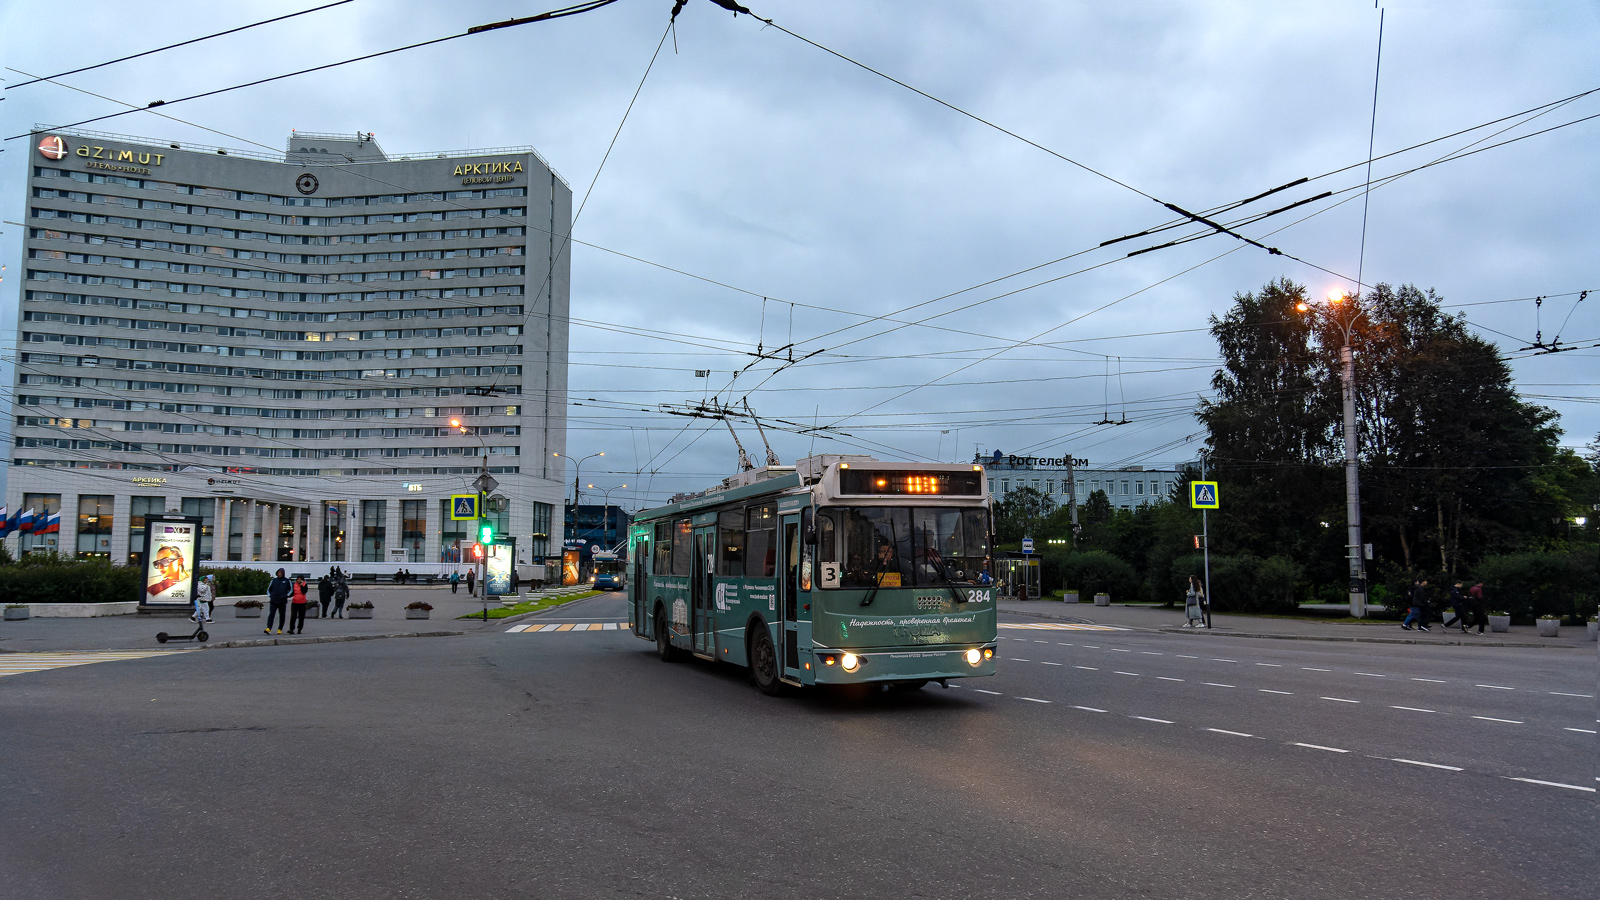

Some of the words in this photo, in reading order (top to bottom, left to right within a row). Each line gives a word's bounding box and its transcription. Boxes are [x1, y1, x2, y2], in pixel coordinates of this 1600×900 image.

[453, 160, 523, 176] АРКТИКА
[131, 476, 167, 484] АРКТИКА
[826, 567, 836, 581] 3
[968, 590, 991, 603] 284
[849, 618, 896, 629] Надежность,
[899, 616, 941, 627] проверенная
